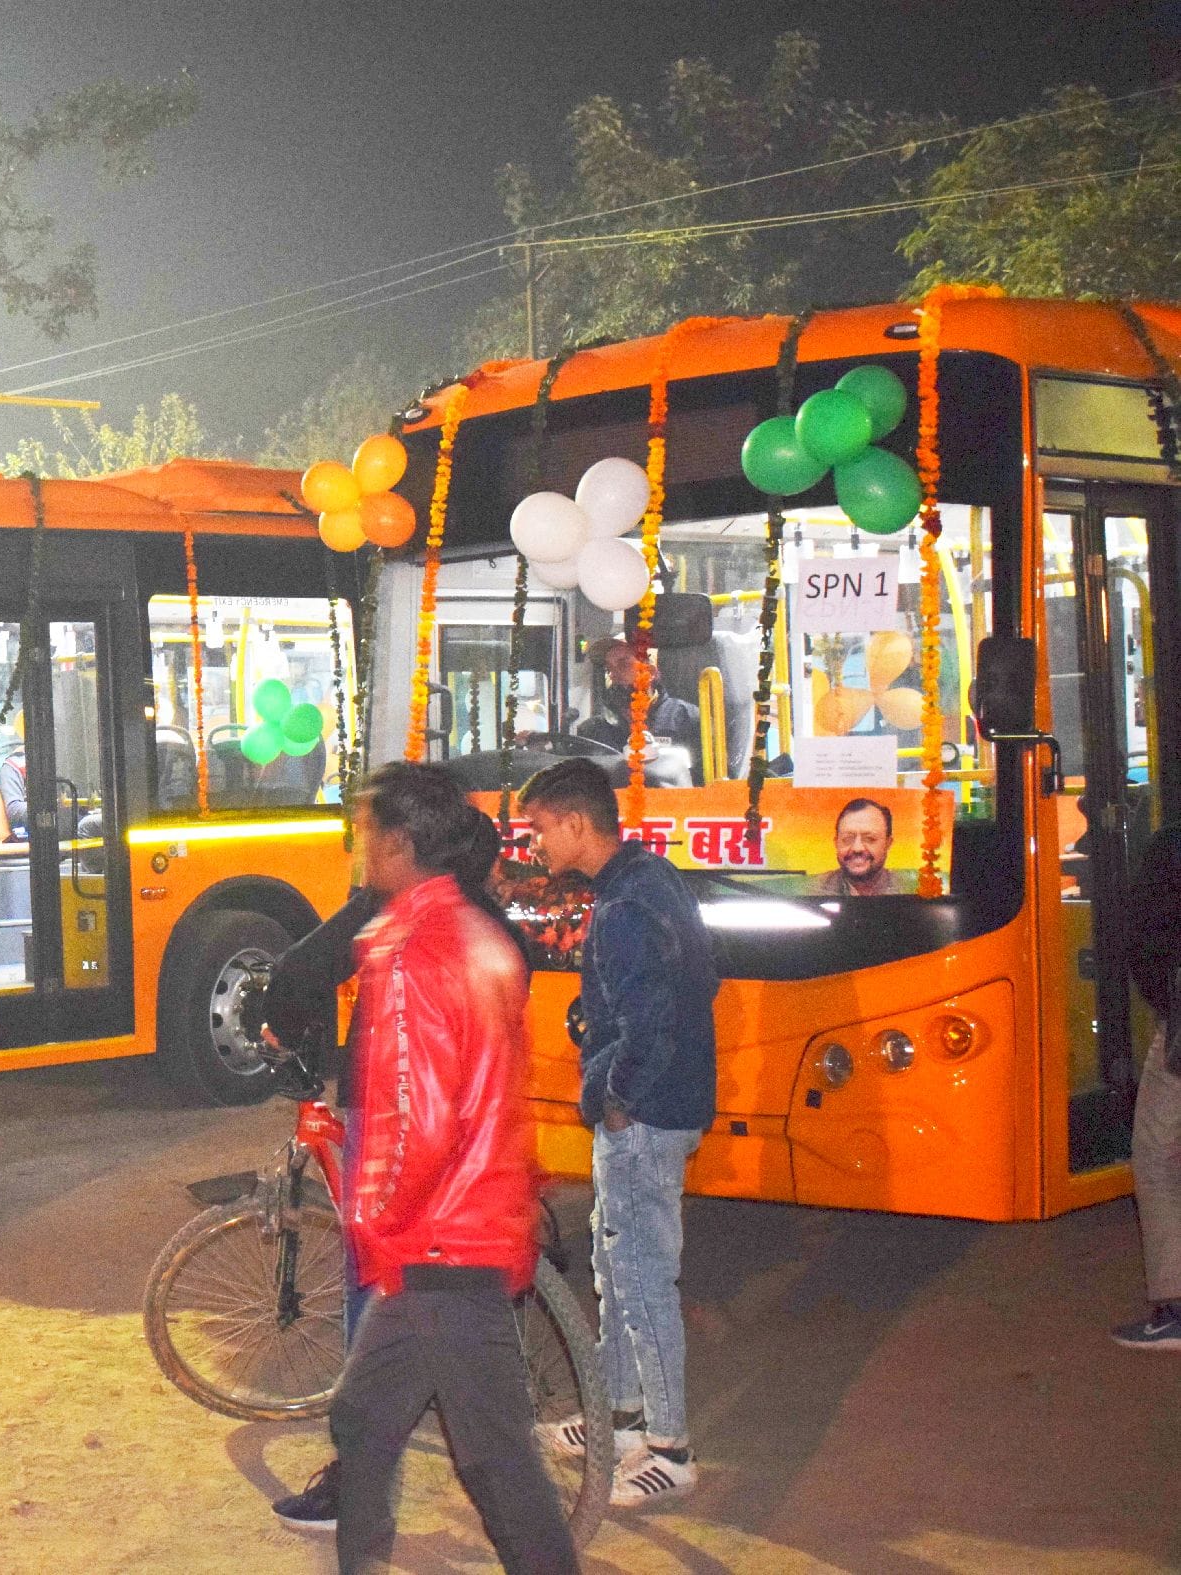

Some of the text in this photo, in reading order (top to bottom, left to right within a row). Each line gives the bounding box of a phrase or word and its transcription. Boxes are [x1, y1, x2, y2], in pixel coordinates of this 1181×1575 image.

[805, 571, 889, 599] SPN 1
[686, 819, 771, 865] बस
